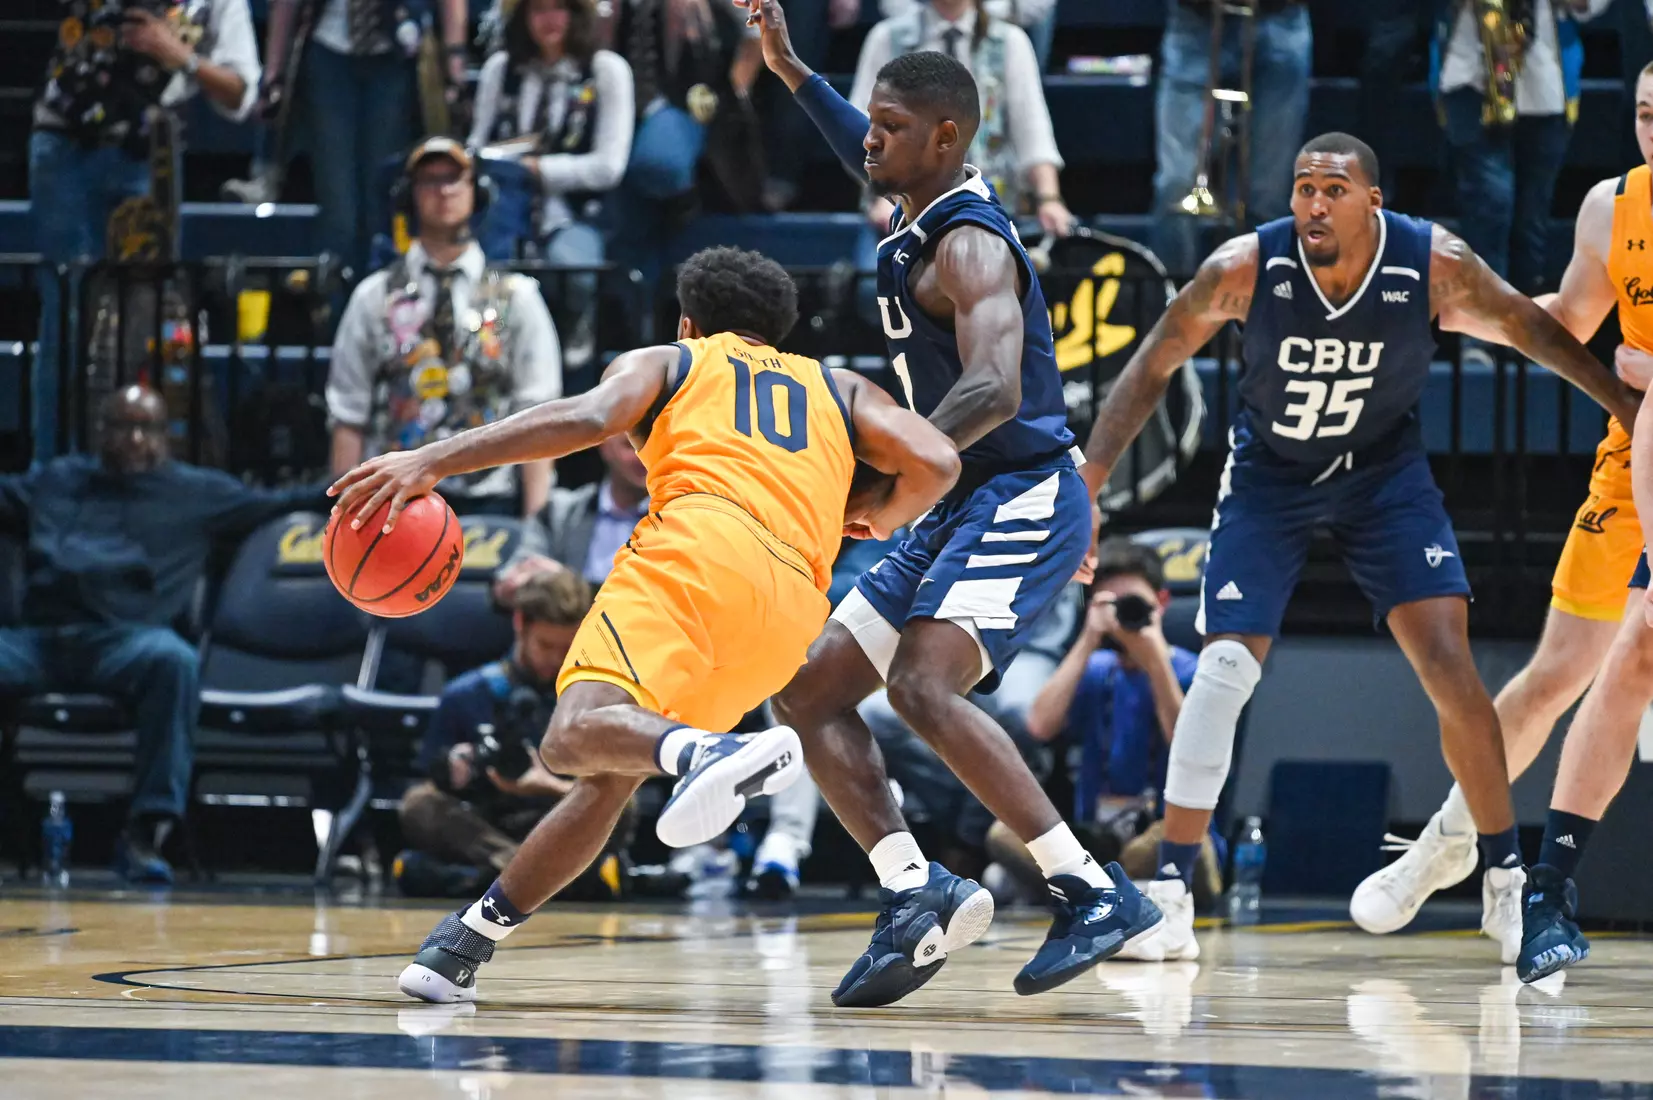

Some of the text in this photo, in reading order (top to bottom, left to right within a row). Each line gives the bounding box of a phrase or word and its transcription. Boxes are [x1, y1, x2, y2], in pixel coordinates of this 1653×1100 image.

[892, 248, 910, 265] AC
[1381, 290, 1410, 302] WAC
[1277, 336, 1385, 374] CBU
[726, 354, 808, 453] 10
[1271, 376, 1374, 441] 35
[414, 543, 460, 602] NCAA
